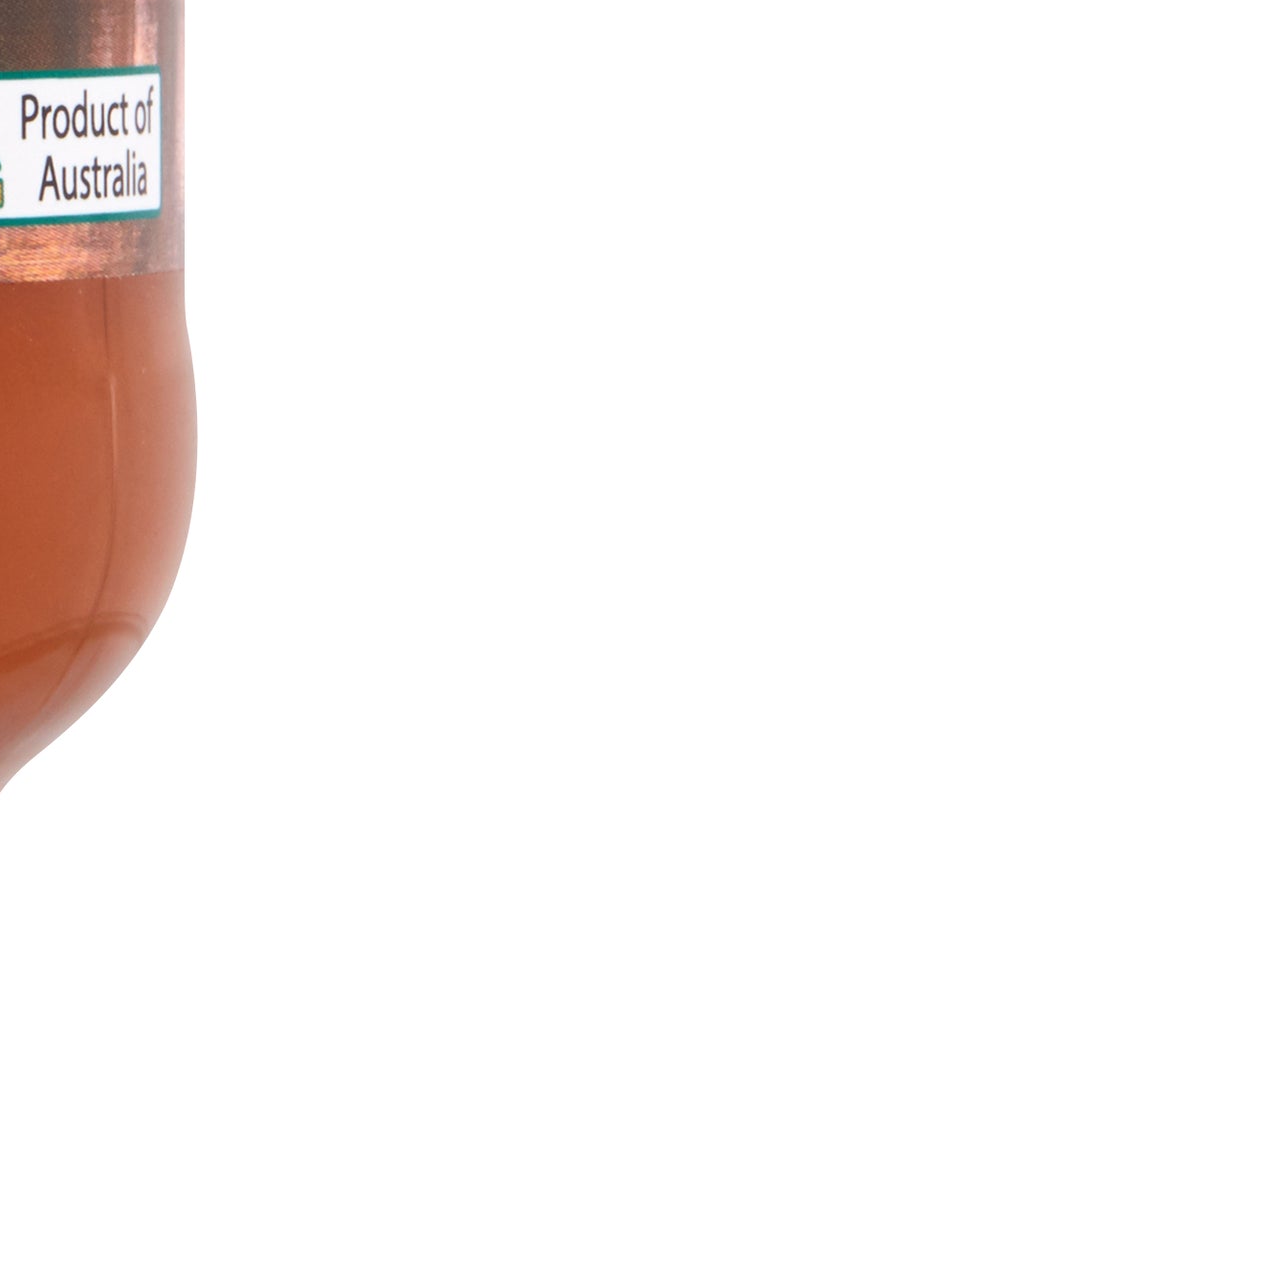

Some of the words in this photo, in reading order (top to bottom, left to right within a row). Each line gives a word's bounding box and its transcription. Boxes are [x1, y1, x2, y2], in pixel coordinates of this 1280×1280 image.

[19, 89, 131, 142] Product
[131, 84, 156, 135] of
[36, 149, 150, 204] Australia
